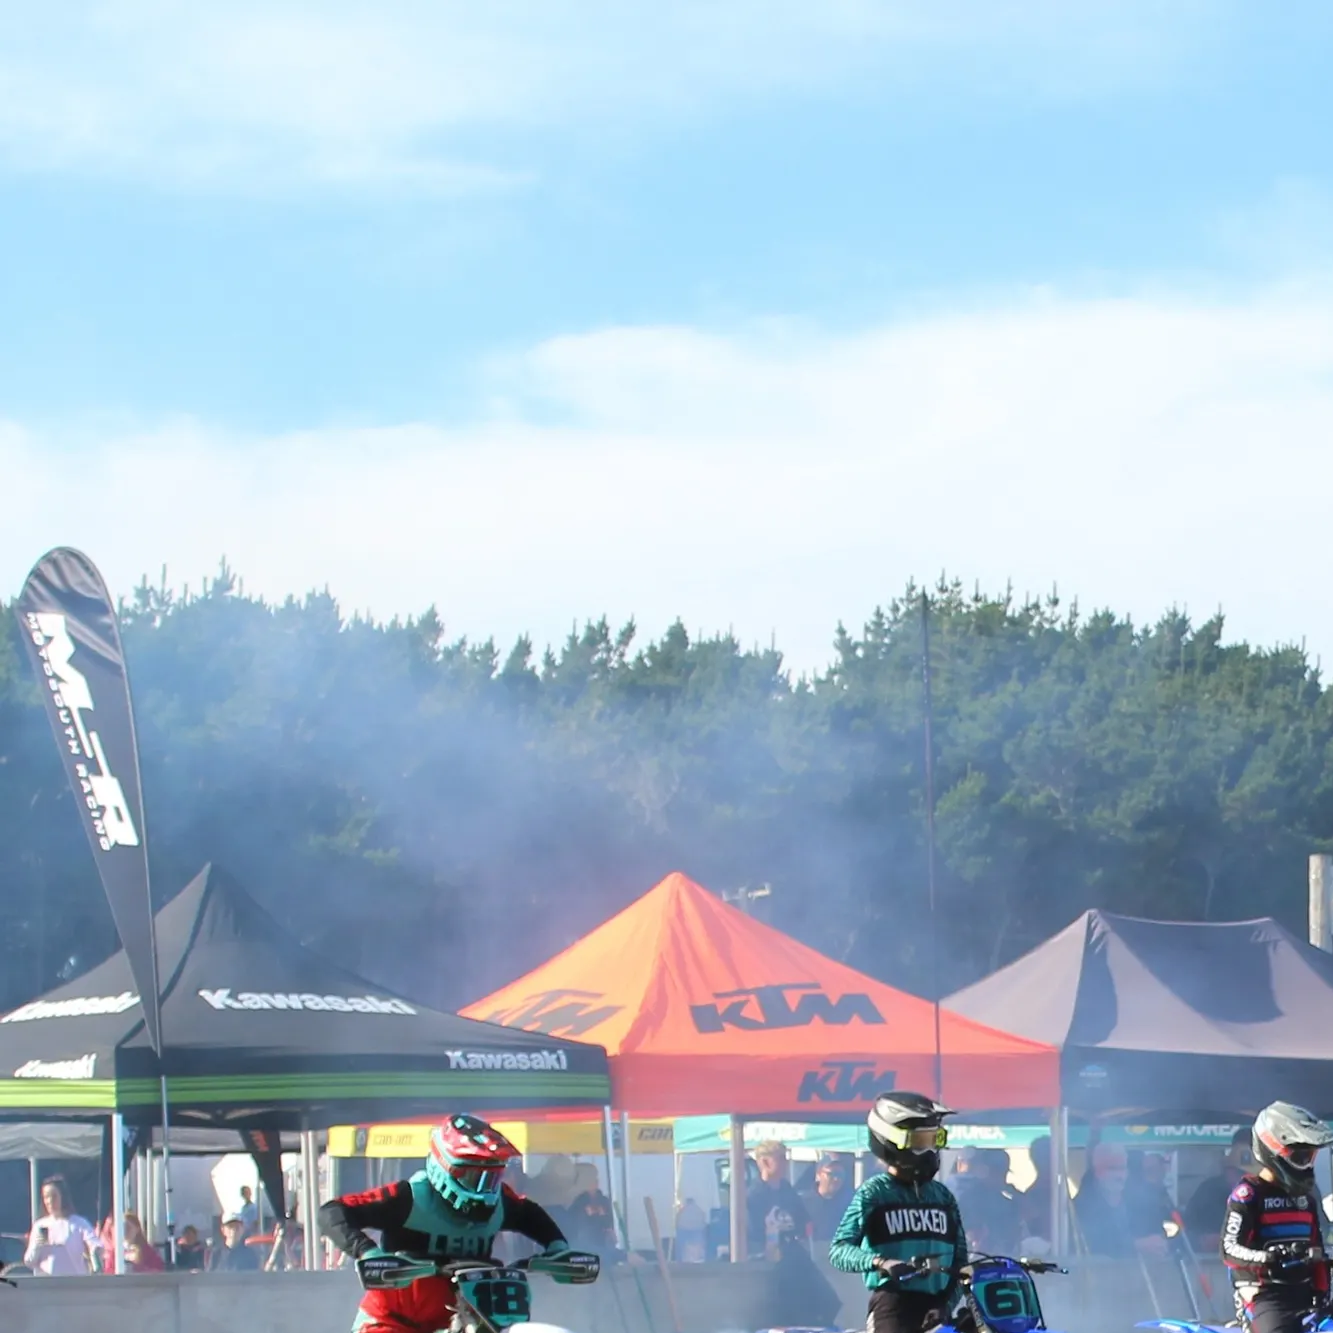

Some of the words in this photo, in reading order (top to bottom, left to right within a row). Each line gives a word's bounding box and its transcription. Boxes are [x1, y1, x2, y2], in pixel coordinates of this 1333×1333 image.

[27, 612, 80, 755] MOTOSOUTH
[76, 763, 114, 851] RACING
[199, 988, 418, 1016] Kawasaki
[689, 982, 887, 1034] KTM
[444, 1049, 568, 1071] Kawasaki
[797, 1061, 897, 1102] KTM
[637, 1127, 673, 1141] can
[885, 1209, 947, 1235] WICKED
[472, 1281, 530, 1327] 18
